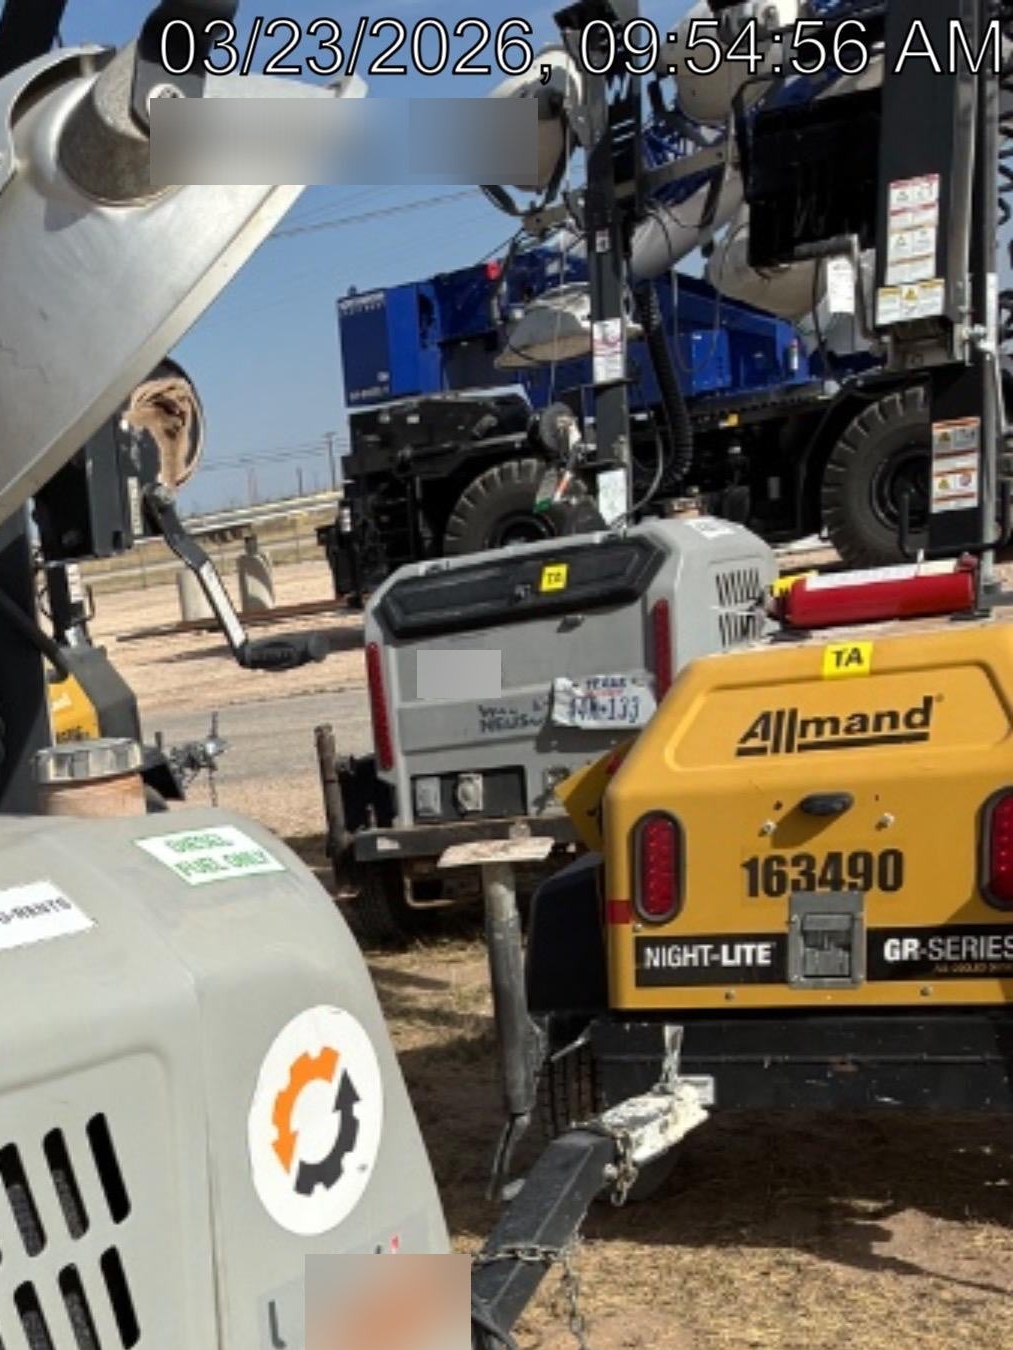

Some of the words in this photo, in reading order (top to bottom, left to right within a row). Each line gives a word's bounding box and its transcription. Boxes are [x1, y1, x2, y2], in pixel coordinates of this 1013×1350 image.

[831, 647, 865, 669] TA
[737, 695, 935, 754] Allmand
[174, 857, 229, 877] FUEL
[223, 849, 270, 868] ONLY
[740, 847, 905, 898] 163490
[644, 942, 774, 968] NIGHT-LITE
[883, 935, 1013, 962] GR-SERIES
